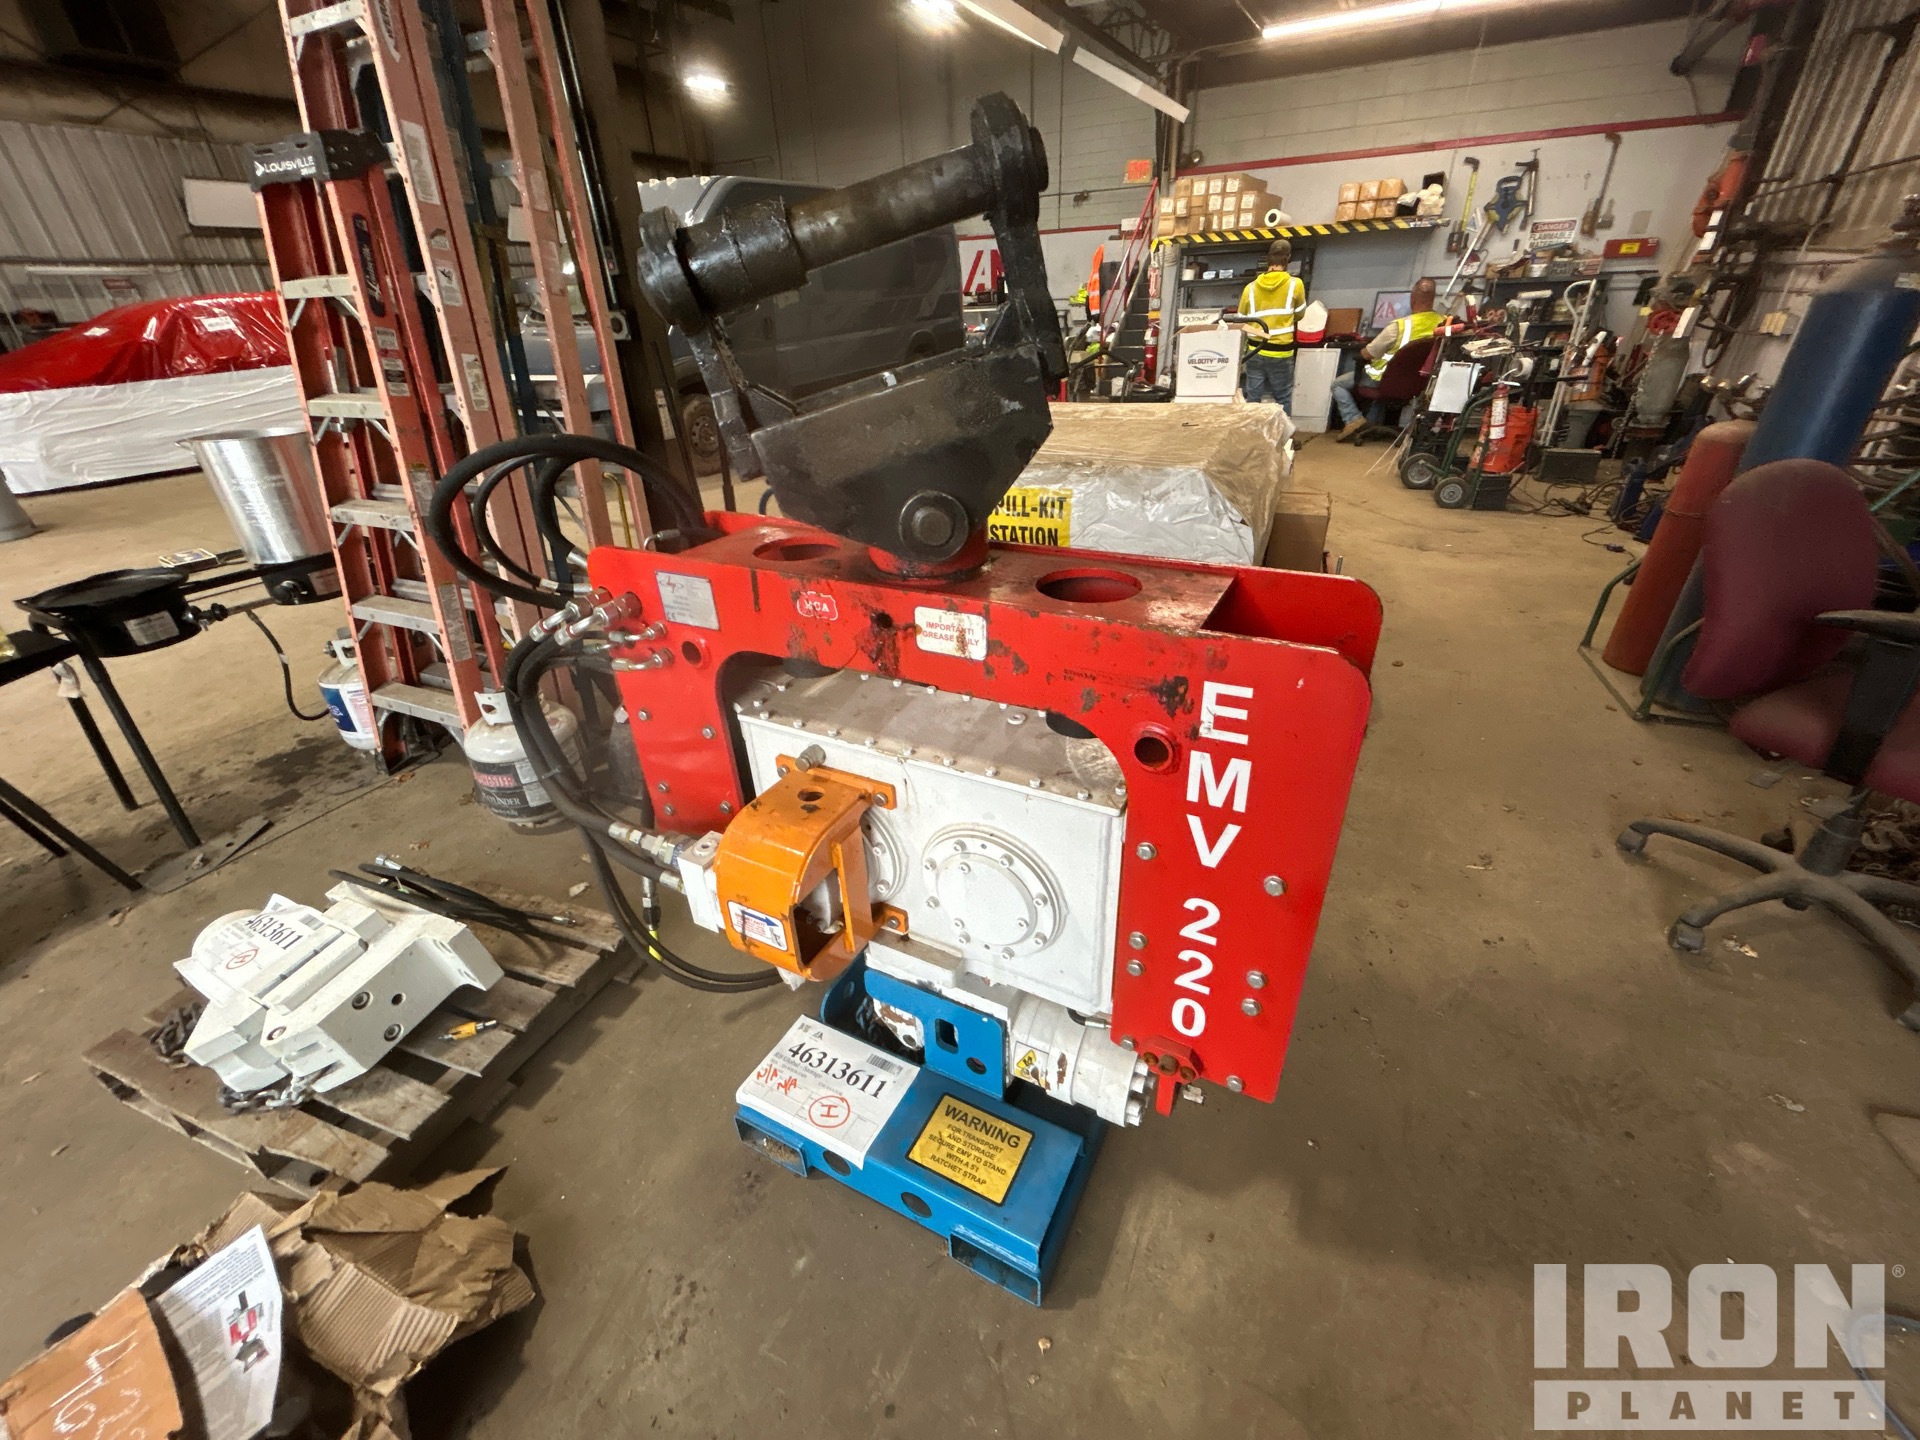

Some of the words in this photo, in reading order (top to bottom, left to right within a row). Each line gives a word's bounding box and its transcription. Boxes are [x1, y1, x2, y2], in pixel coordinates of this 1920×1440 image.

[264, 155, 315, 173] LOUISVILLE
[989, 524, 1059, 547] STATION
[922, 630, 955, 642] GREASE
[1186, 681, 1254, 869] EMV
[1171, 897, 1221, 1038] 220
[788, 1042, 887, 1099] 46313611
[945, 1104, 1021, 1148] WARNING
[947, 1124, 961, 1135] FOR
[963, 1130, 1003, 1153] TRANSPORT
[928, 1133, 955, 1150] SECURE
[956, 1148, 971, 1158] EMV
[973, 1154, 983, 1163] TO
[983, 1160, 1007, 1176] STAND
[946, 1152, 963, 1164] WITH
[947, 1133, 962, 1144] AND
[962, 1139, 996, 1160] STORAGE
[930, 1154, 963, 1174] RATCHET
[963, 1170, 987, 1186] STRAP
